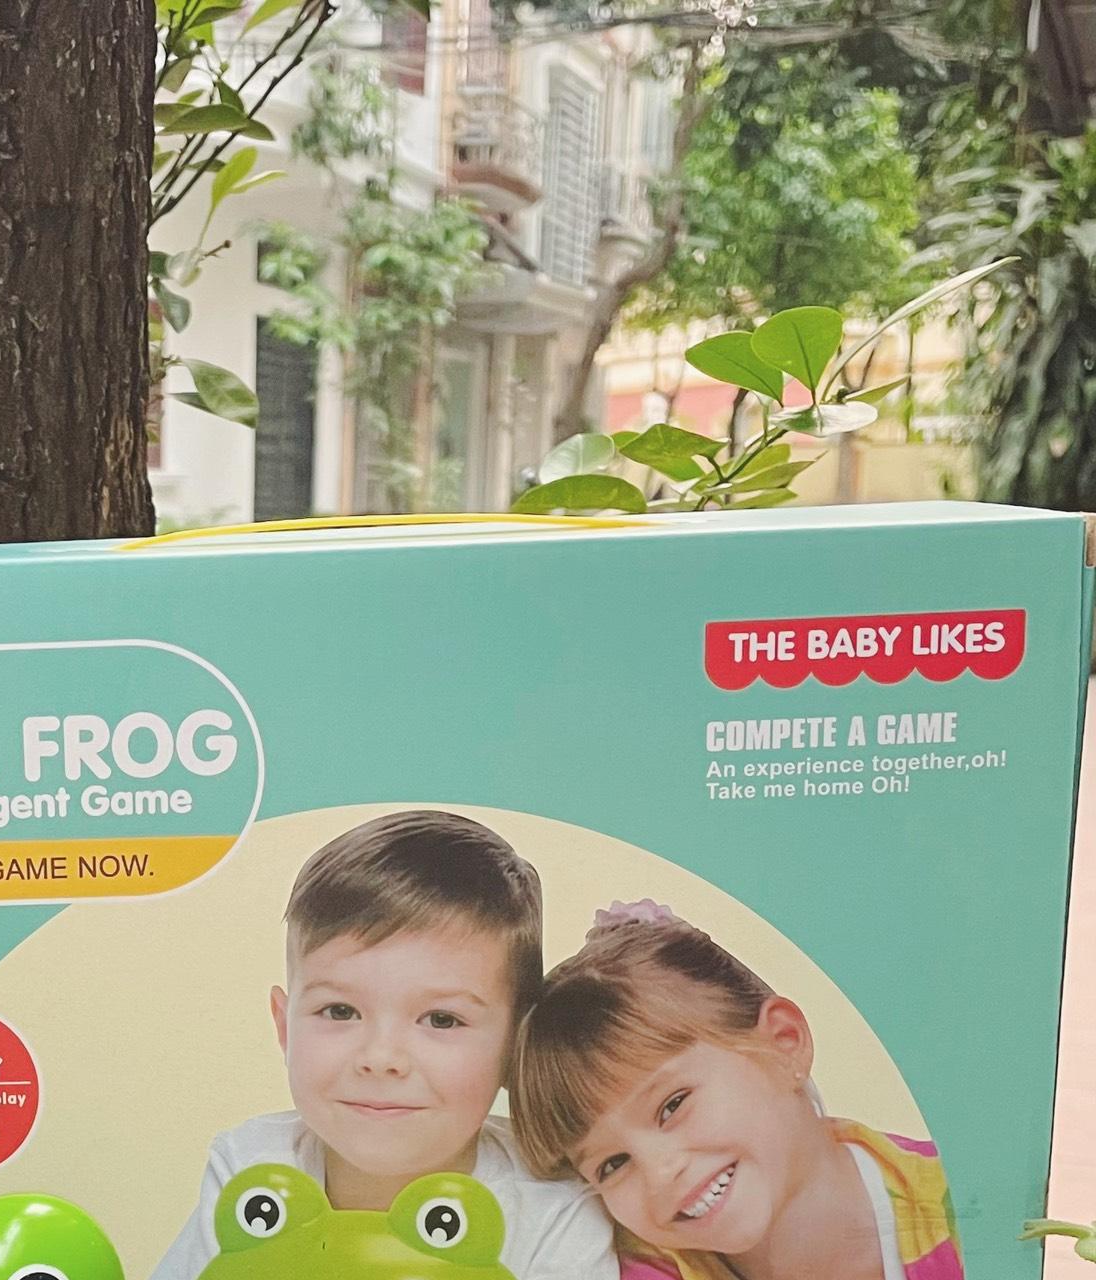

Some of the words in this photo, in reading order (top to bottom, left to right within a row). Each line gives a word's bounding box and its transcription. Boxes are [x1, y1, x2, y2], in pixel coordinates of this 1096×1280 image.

[728, 630, 796, 663] THE
[807, 625, 902, 660] BABY
[912, 622, 1006, 656] LIKES
[23, 709, 238, 782] FROG
[706, 716, 837, 752] COMPETE
[847, 716, 866, 747] A
[877, 712, 957, 745] GAME
[706, 761, 736, 778] An
[743, 755, 864, 779] experience
[872, 750, 1007, 775] together,oh!
[81, 785, 193, 817] Game
[706, 782, 756, 800] Take
[764, 784, 796, 798] me
[804, 779, 864, 796] home
[871, 775, 910, 794] Oh!
[78, 854, 155, 878] NOW.
